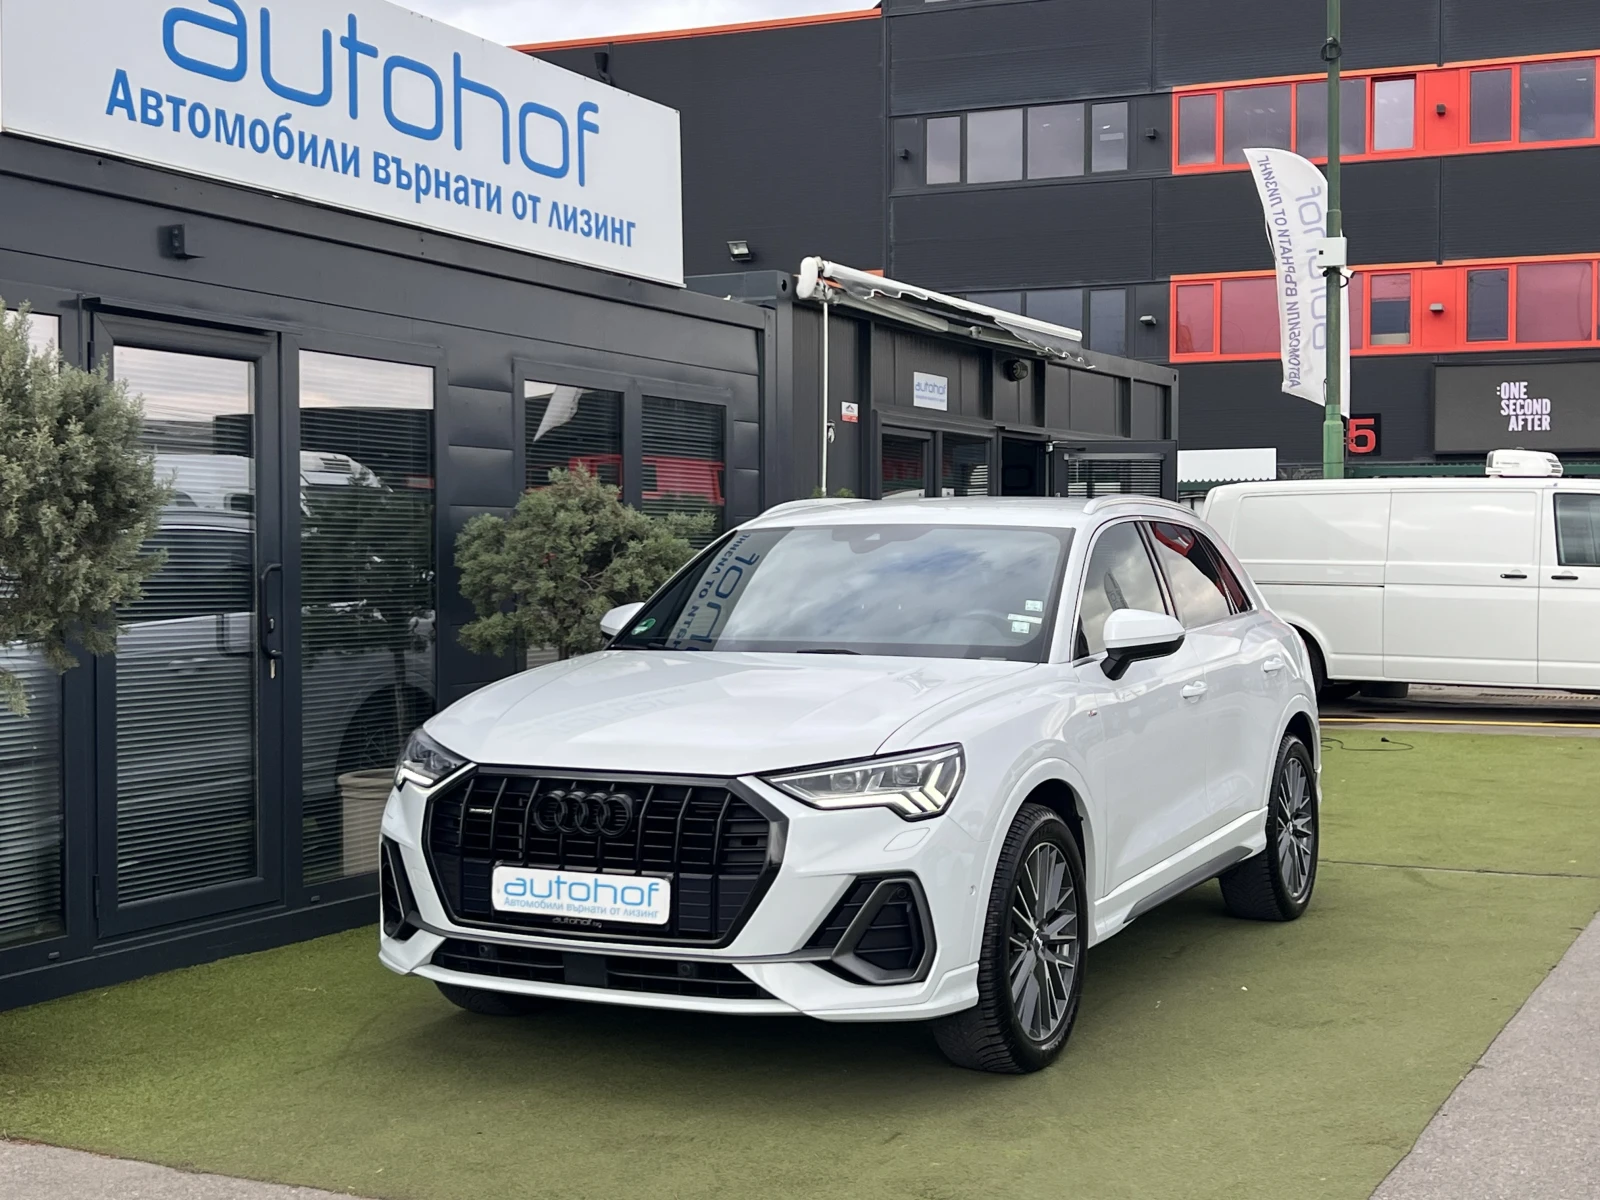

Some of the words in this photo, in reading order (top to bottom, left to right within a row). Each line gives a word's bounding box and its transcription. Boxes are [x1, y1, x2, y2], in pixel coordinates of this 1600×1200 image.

[161, 0, 600, 187] autohof
[105, 68, 361, 178] Автомобили
[372, 150, 503, 216] върнати
[511, 191, 543, 223] от
[548, 201, 636, 248] лизинг
[1500, 398, 1551, 415] SECOND
[1508, 414, 1551, 431] AFTER
[1348, 418, 1376, 453] 5
[504, 875, 660, 907] autohof
[610, 906, 621, 916] от
